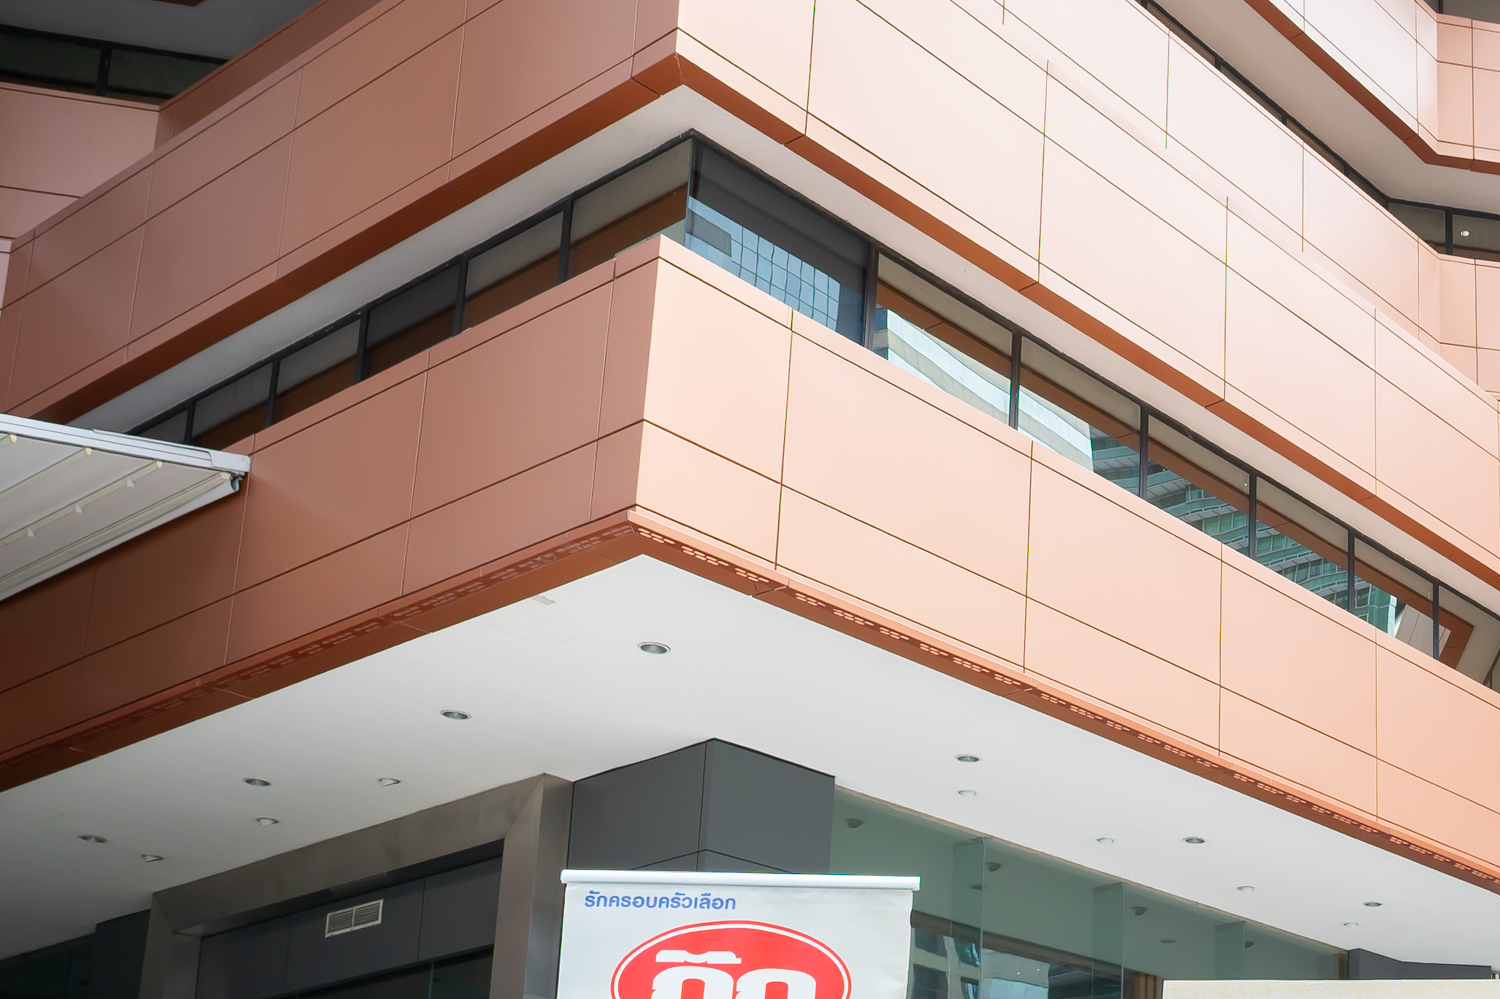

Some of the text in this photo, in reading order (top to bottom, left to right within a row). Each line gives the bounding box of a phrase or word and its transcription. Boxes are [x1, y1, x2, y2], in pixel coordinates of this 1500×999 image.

[584, 890, 736, 911] รักครอบครัวเลือก
